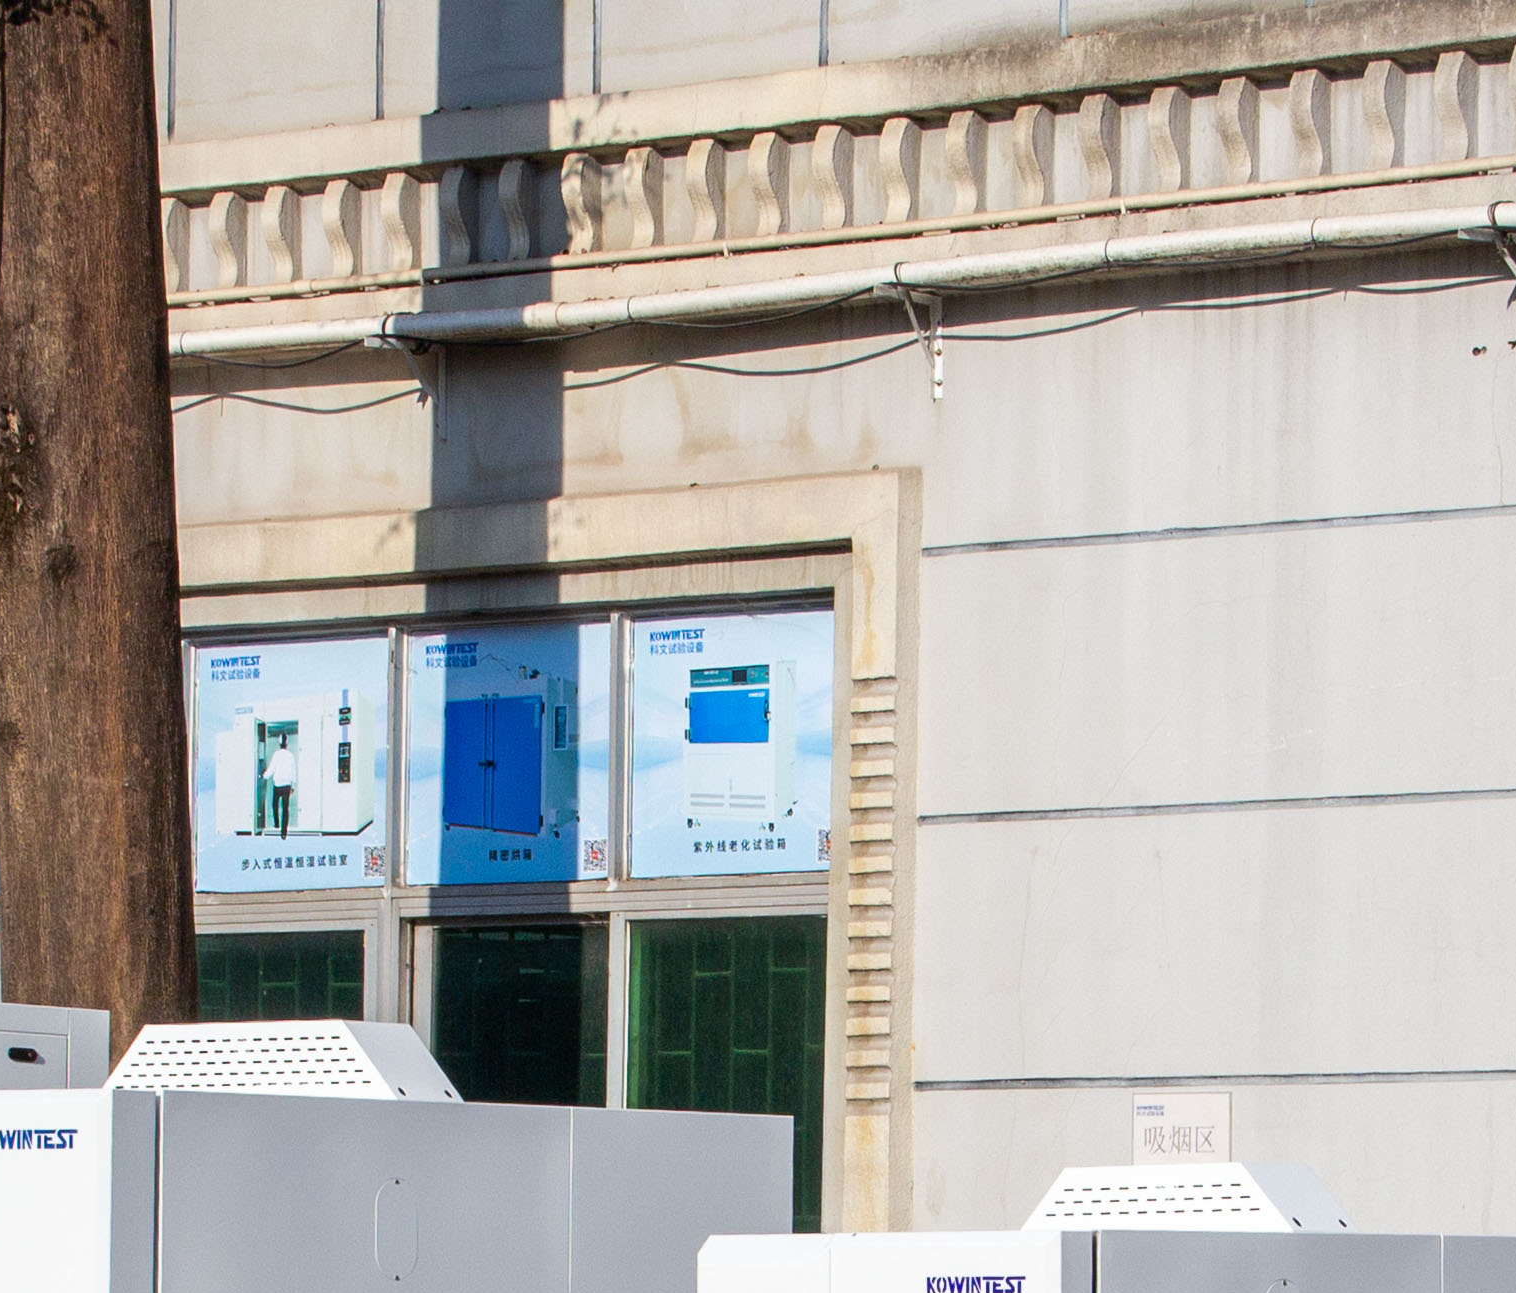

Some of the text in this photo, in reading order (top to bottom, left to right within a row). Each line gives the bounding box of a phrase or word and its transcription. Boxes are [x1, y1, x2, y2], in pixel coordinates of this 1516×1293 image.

[649, 629, 705, 642] KOWINTEST
[425, 642, 479, 655] KOWINTEST
[649, 642, 704, 655] 科文试验设备
[210, 655, 261, 668] KOWINTEST
[425, 655, 478, 668] 科文试验设备
[211, 668, 261, 681] 科文试验设备
[693, 838, 786, 853] 紫外线老化试验箱
[1144, 1125, 1215, 1154] 吸烟区
